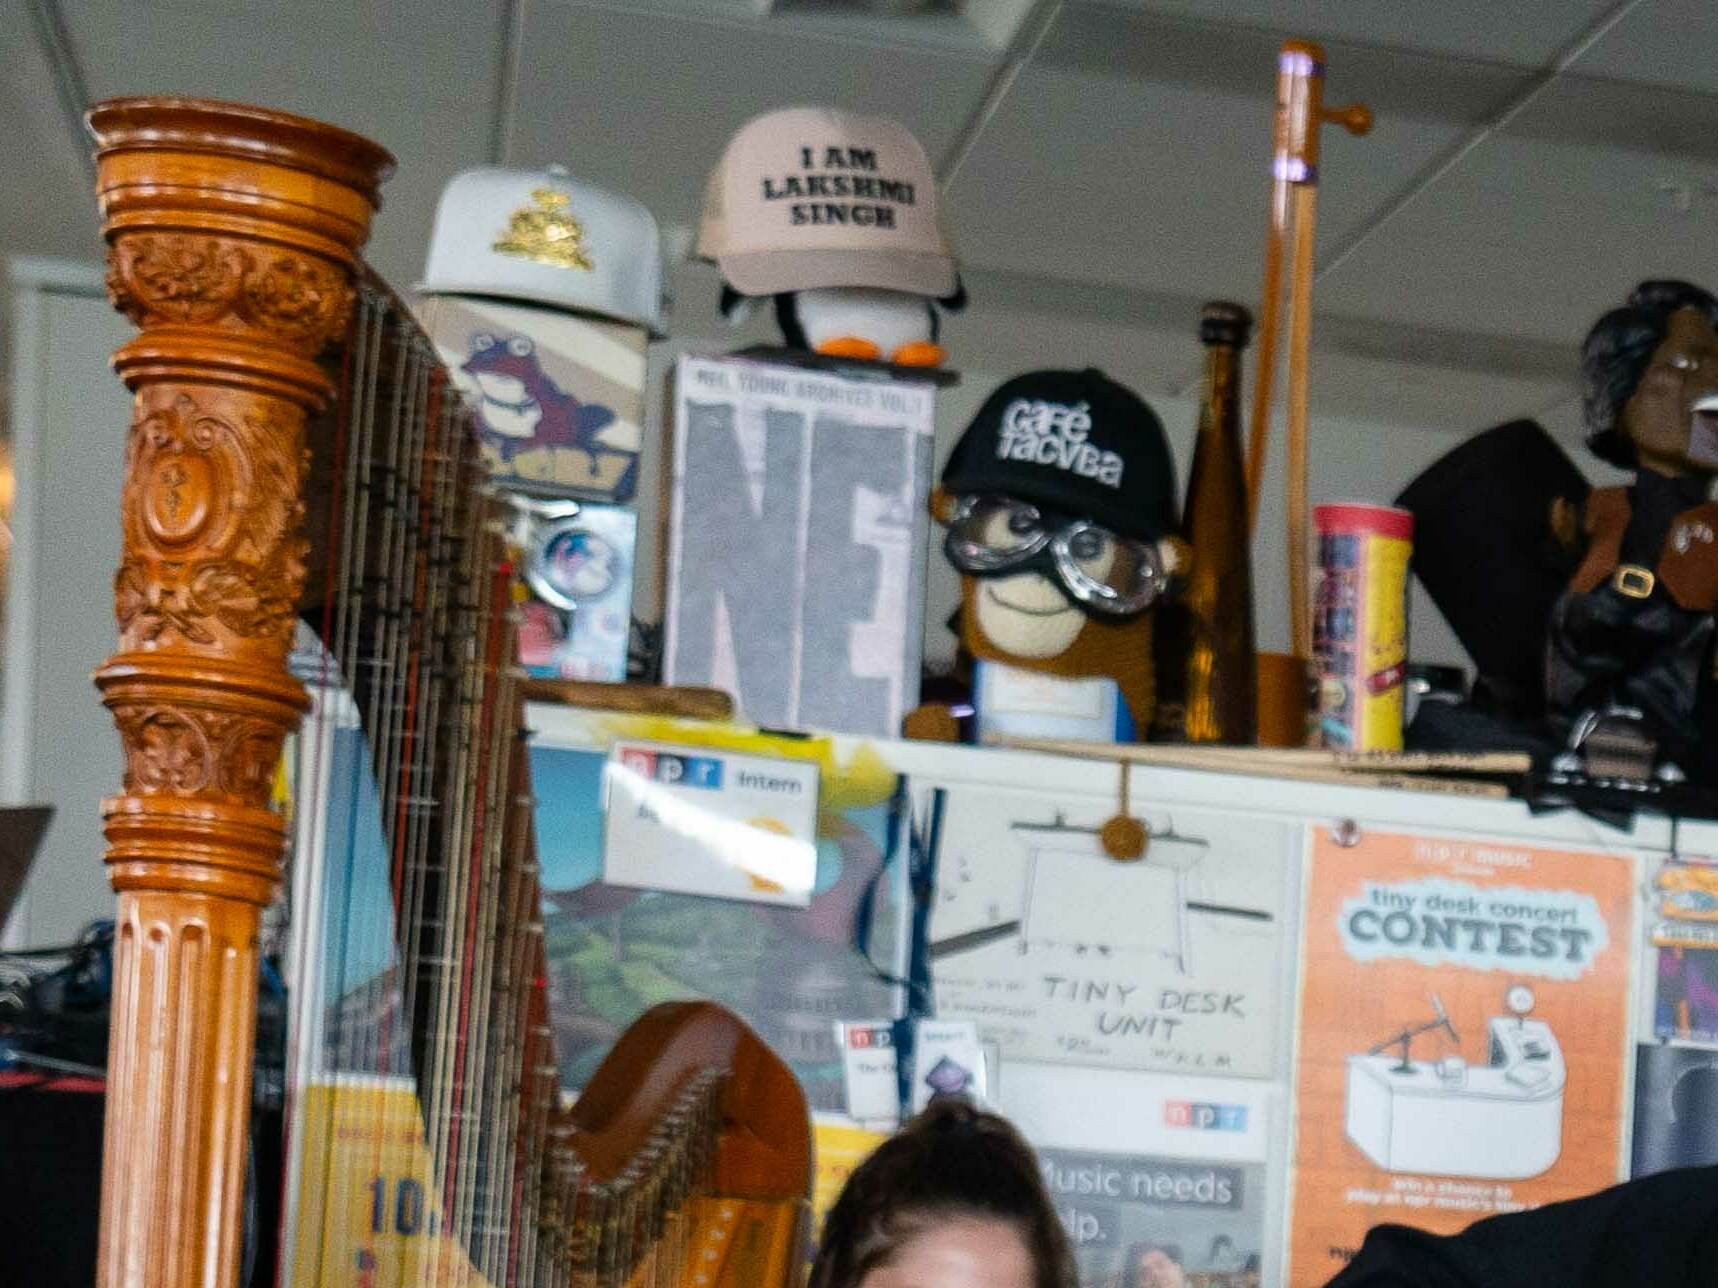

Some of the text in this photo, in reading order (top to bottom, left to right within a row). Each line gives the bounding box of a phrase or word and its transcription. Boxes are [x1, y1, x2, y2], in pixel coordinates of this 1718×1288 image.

[826, 149, 877, 170] AM
[764, 177, 916, 204] LAKSHMI
[791, 205, 896, 228] SINGH
[1370, 887, 1579, 921] tiny desk concert
[1349, 909, 1591, 963] CONTEST
[1042, 976, 1247, 1019] TINY DESK
[1097, 1011, 1182, 1041] UNIT
[1165, 1101, 1248, 1131] npr
[1132, 1168, 1234, 1203] needs
